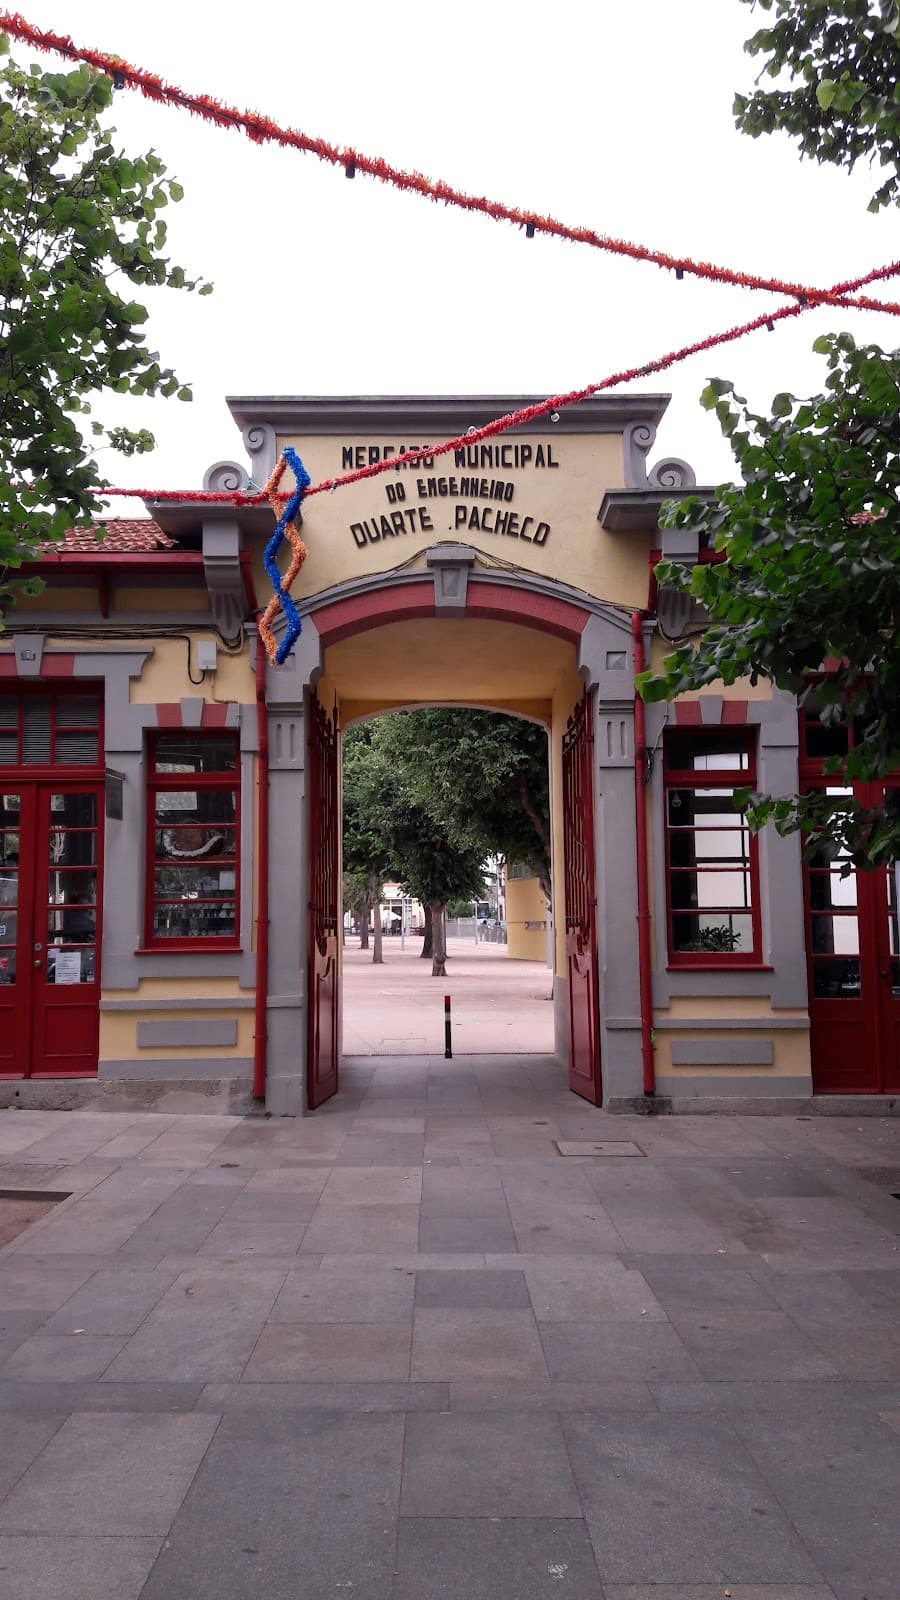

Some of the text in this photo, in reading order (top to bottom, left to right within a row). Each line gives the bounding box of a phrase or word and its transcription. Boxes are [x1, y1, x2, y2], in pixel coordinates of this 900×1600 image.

[454, 444, 559, 469] MUNICIPAL
[385, 476, 515, 504] DO ENGENHEIRO
[350, 506, 434, 549] DUARTE
